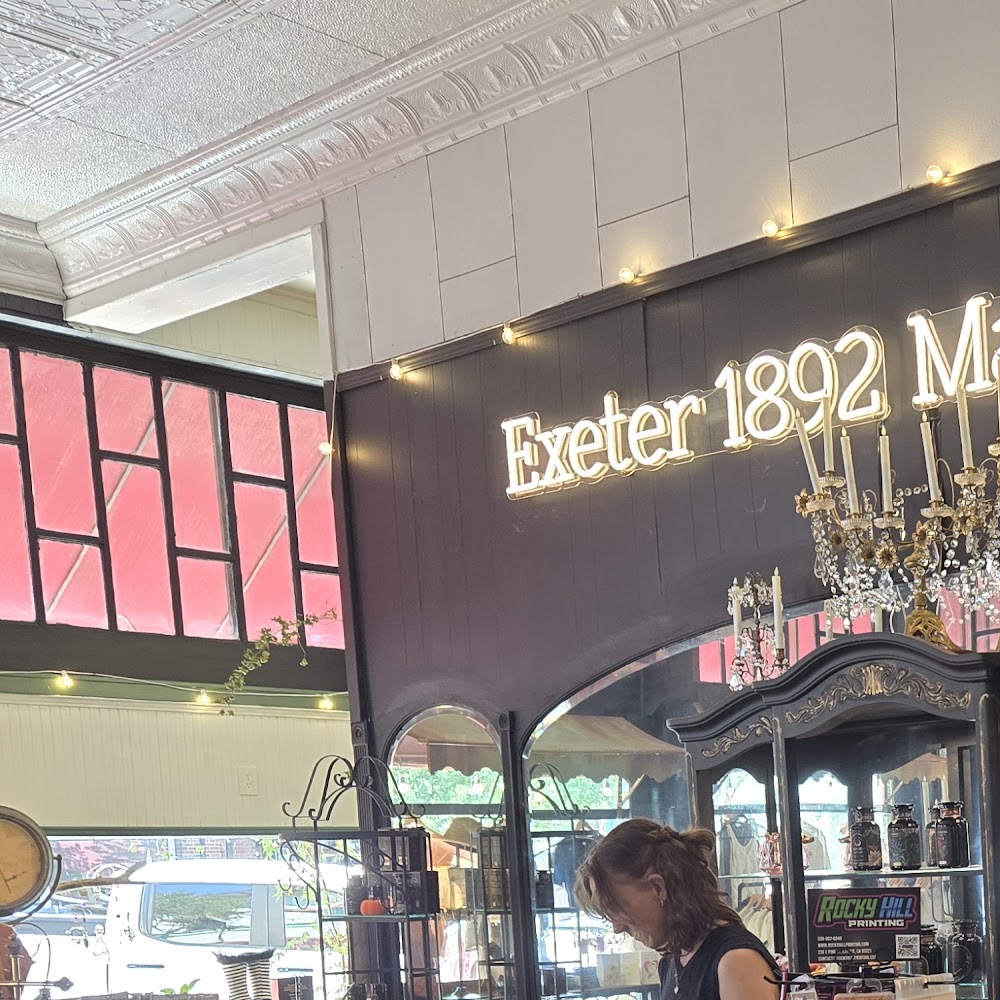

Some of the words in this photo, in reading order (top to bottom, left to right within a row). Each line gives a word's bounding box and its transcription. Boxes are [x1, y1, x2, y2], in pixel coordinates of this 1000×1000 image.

[502, 389, 706, 495] Exeter
[715, 330, 888, 451] 1892
[818, 896, 878, 922] ROCKY
[879, 896, 913, 918] HILL
[848, 919, 904, 927] PRINTING
